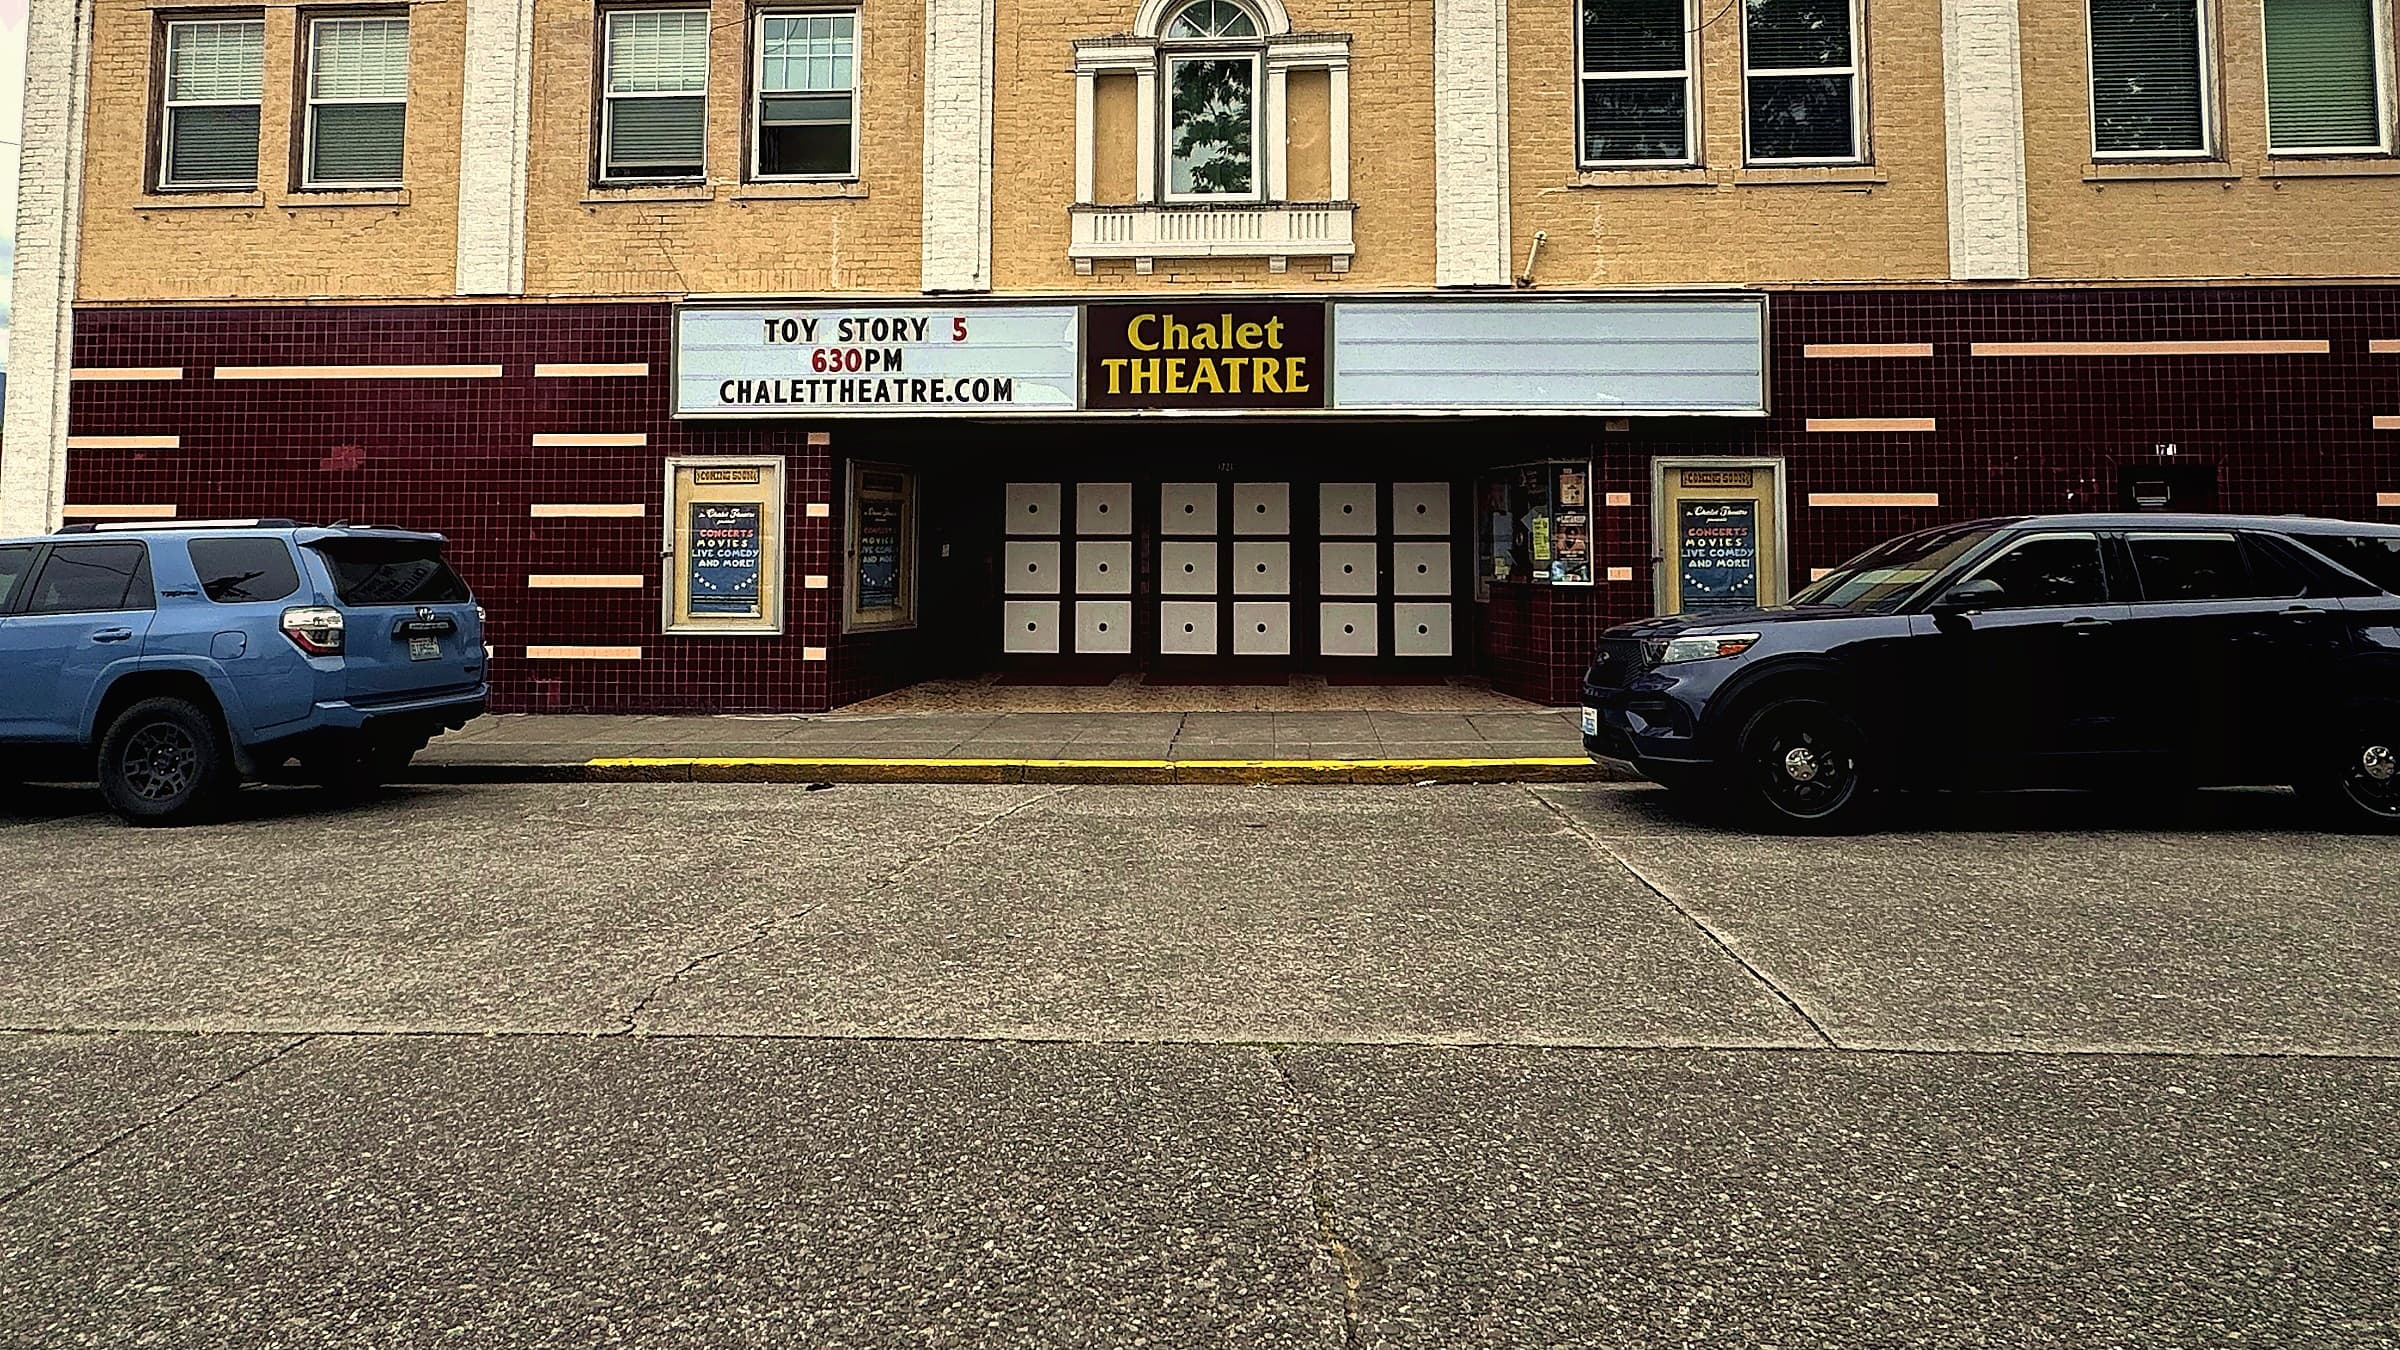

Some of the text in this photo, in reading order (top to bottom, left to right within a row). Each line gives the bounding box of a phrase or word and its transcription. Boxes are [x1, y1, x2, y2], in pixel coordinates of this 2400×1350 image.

[764, 316, 967, 343] TOY STORY 5
[1127, 313, 1285, 351] Chalet
[811, 347, 904, 373] 630PM
[1100, 356, 1311, 394] THEATRE
[718, 377, 1014, 404] CHALETTHEATRE.COM
[700, 470, 753, 481] COMING SOON
[1687, 472, 1746, 484] COMING SOON
[699, 529, 754, 538] CONCERTS
[1687, 527, 1748, 536] CONCERTS
[696, 539, 748, 548] MOVIES
[1685, 538, 1742, 547] MOVIES
[691, 549, 760, 558] LIVE COMEDY
[1681, 548, 1754, 558] LIVE COMEDY
[698, 559, 755, 568] AND MORE!
[1688, 558, 1750, 568] AND MORE!
